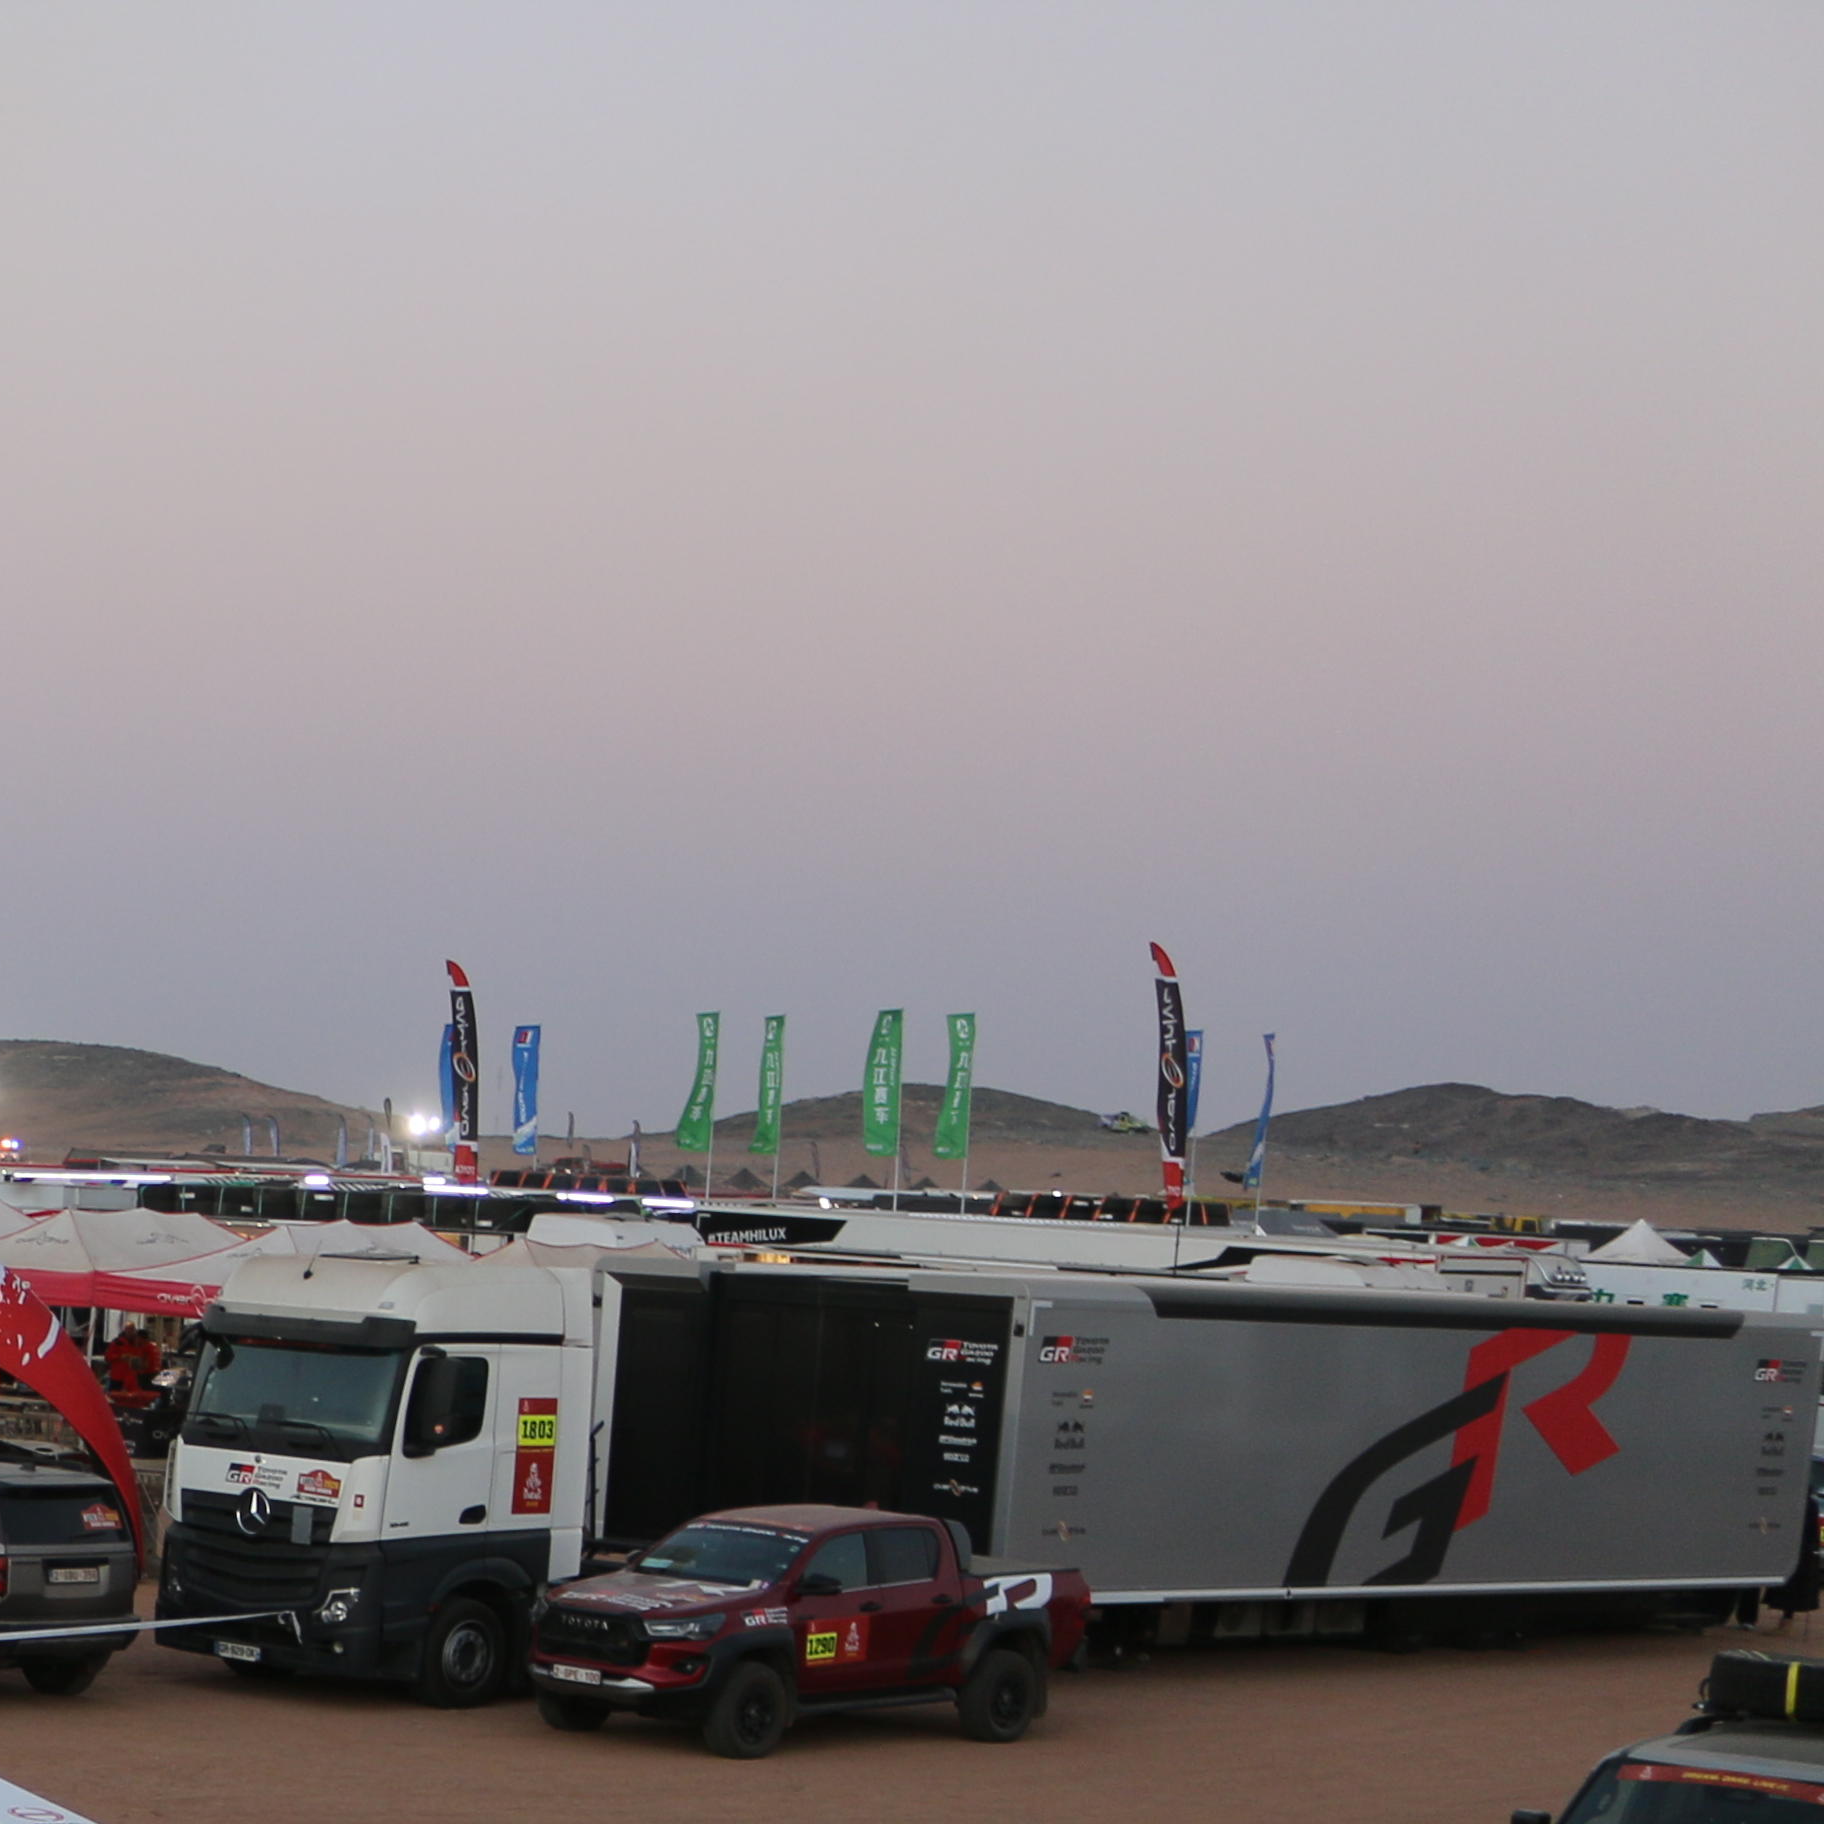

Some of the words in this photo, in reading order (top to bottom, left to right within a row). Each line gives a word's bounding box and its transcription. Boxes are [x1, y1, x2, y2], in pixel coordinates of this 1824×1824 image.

[708, 1226, 788, 1244] #TEAMHILUX
[926, 1347, 959, 1362] GR
[1039, 1346, 1070, 1362] GR
[1755, 1366, 1783, 1383] GR
[521, 1420, 554, 1439] 1803
[1283, 1328, 1632, 1587] GR
[226, 1469, 254, 1485] GR
[560, 1614, 609, 1631] TOYOTA
[807, 1636, 836, 1657] 1290
